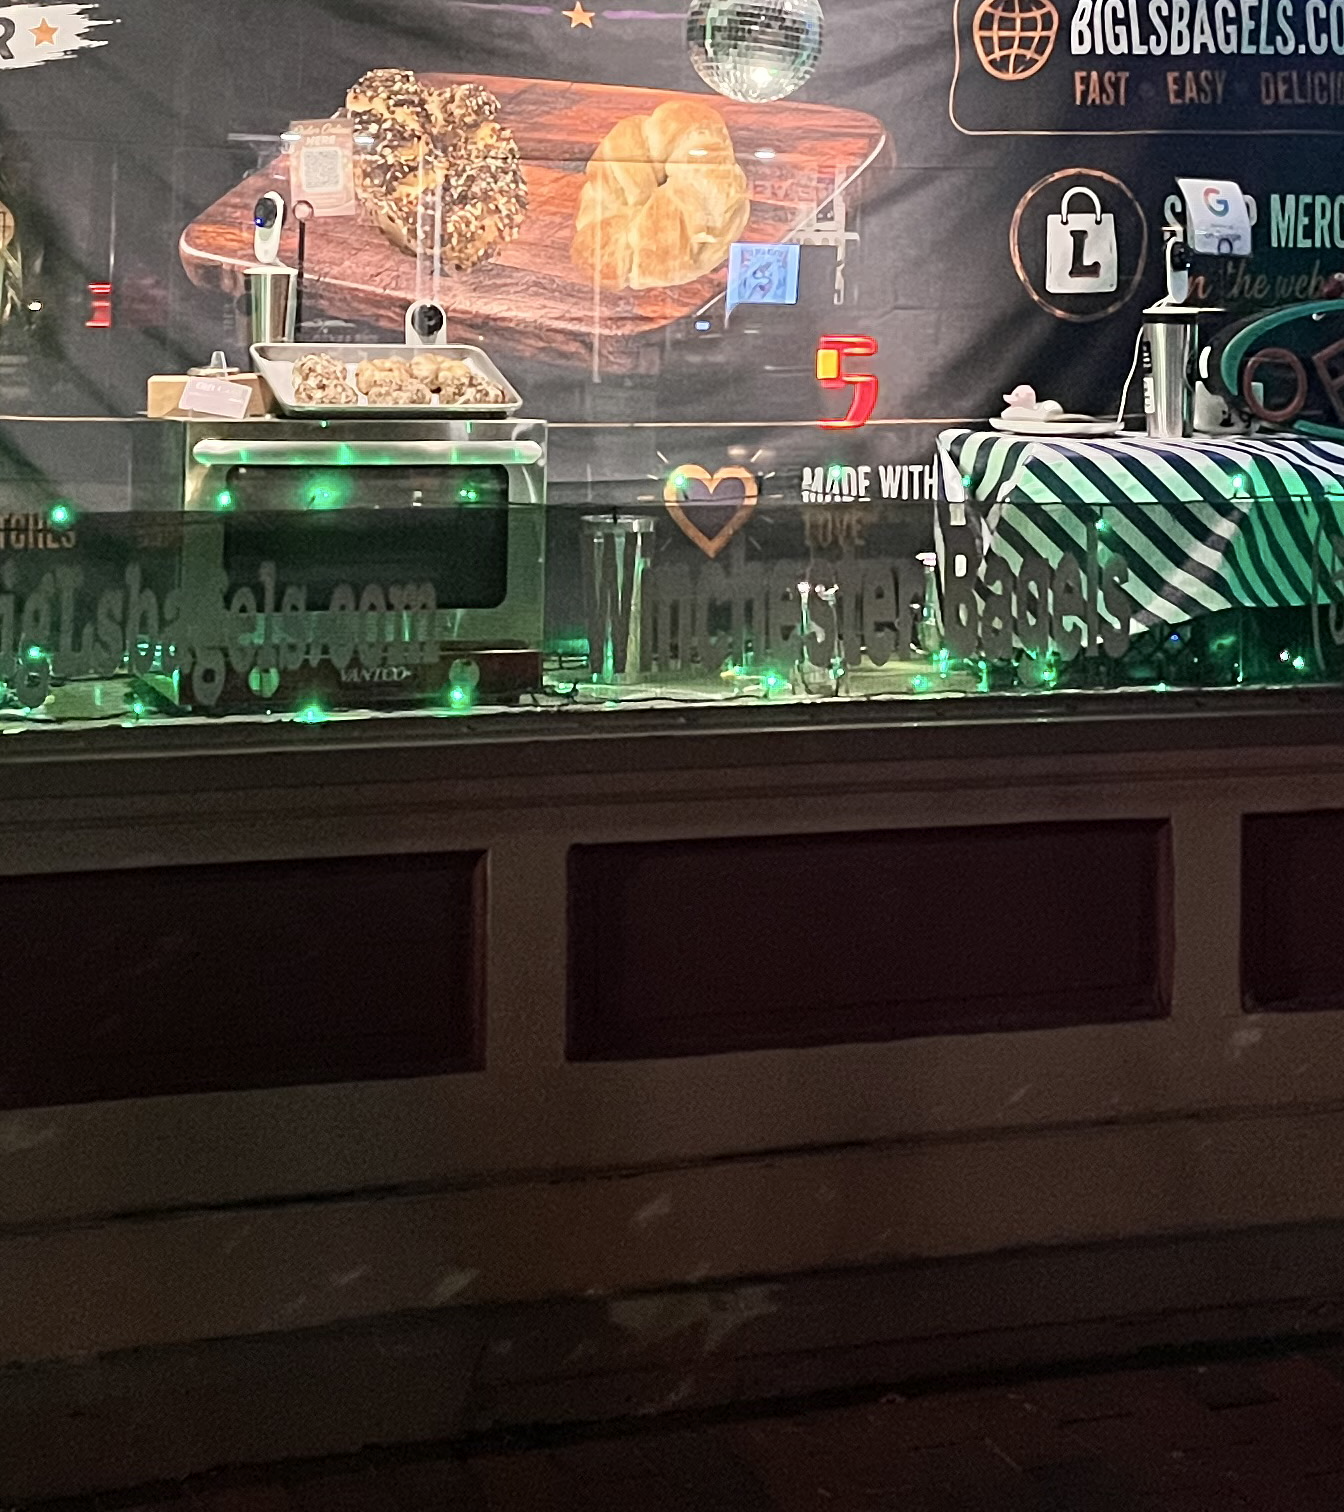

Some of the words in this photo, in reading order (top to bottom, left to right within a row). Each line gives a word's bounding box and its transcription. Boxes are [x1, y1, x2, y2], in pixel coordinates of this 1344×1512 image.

[1074, 70, 1129, 105] FAST
[1167, 70, 1227, 105] EASY
[801, 466, 872, 504] MADE
[878, 464, 938, 501] WITH
